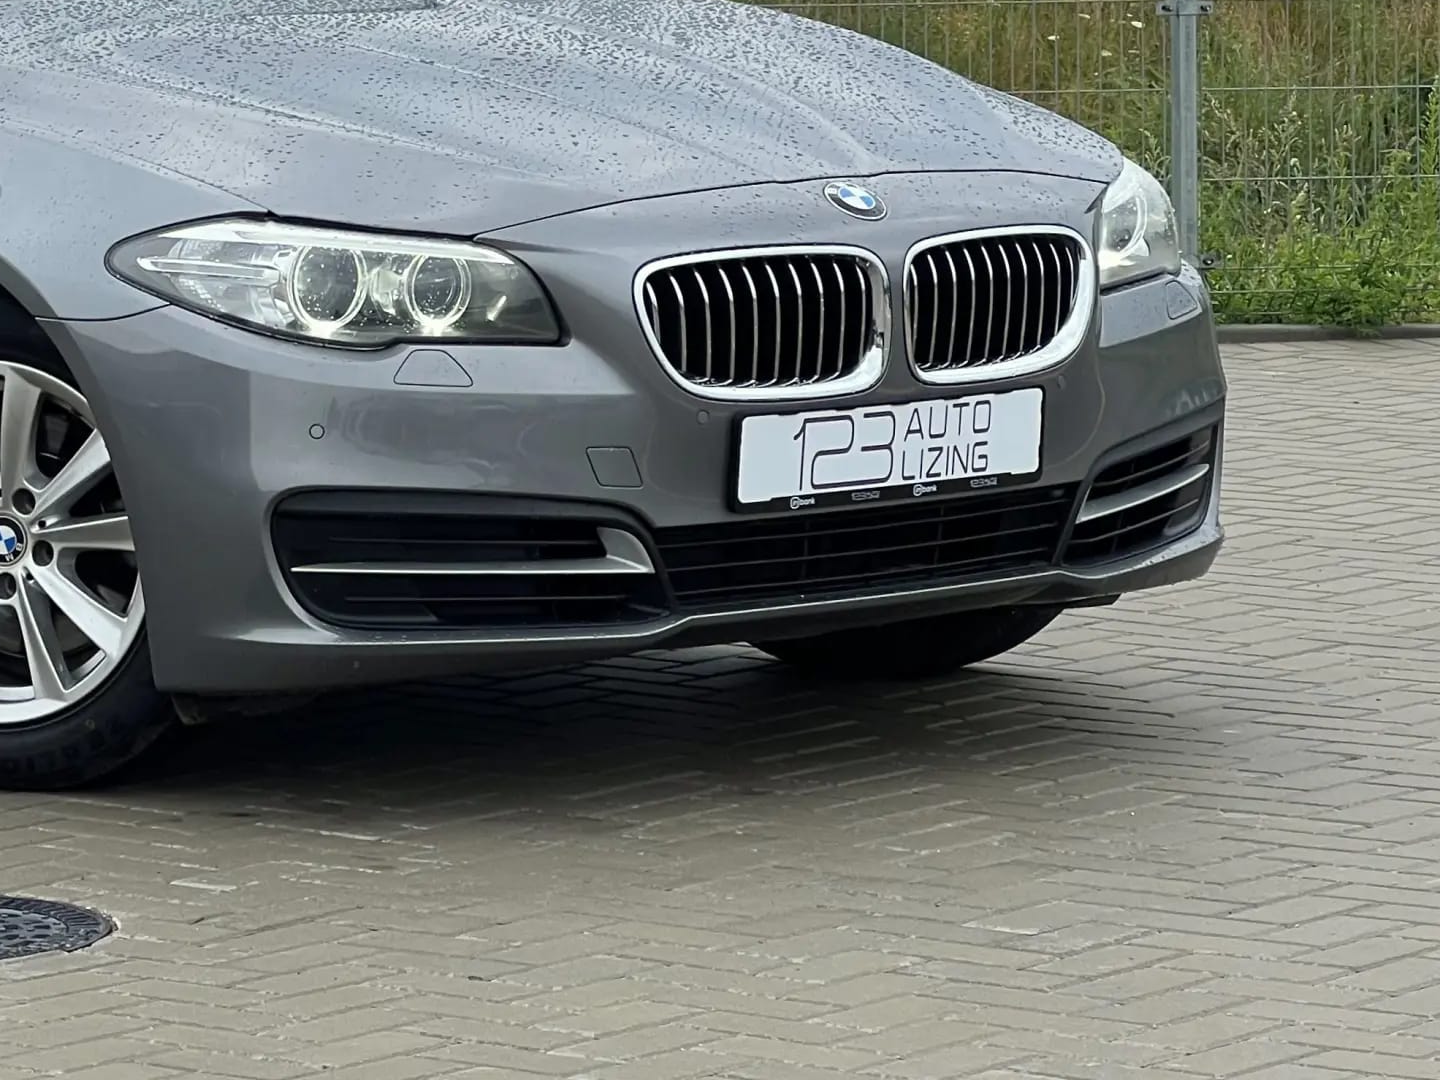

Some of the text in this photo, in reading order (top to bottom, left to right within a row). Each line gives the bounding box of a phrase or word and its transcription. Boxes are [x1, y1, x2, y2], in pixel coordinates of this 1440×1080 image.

[904, 401, 991, 441] AUTO
[793, 411, 896, 491] 123
[902, 442, 989, 480] LIZING
